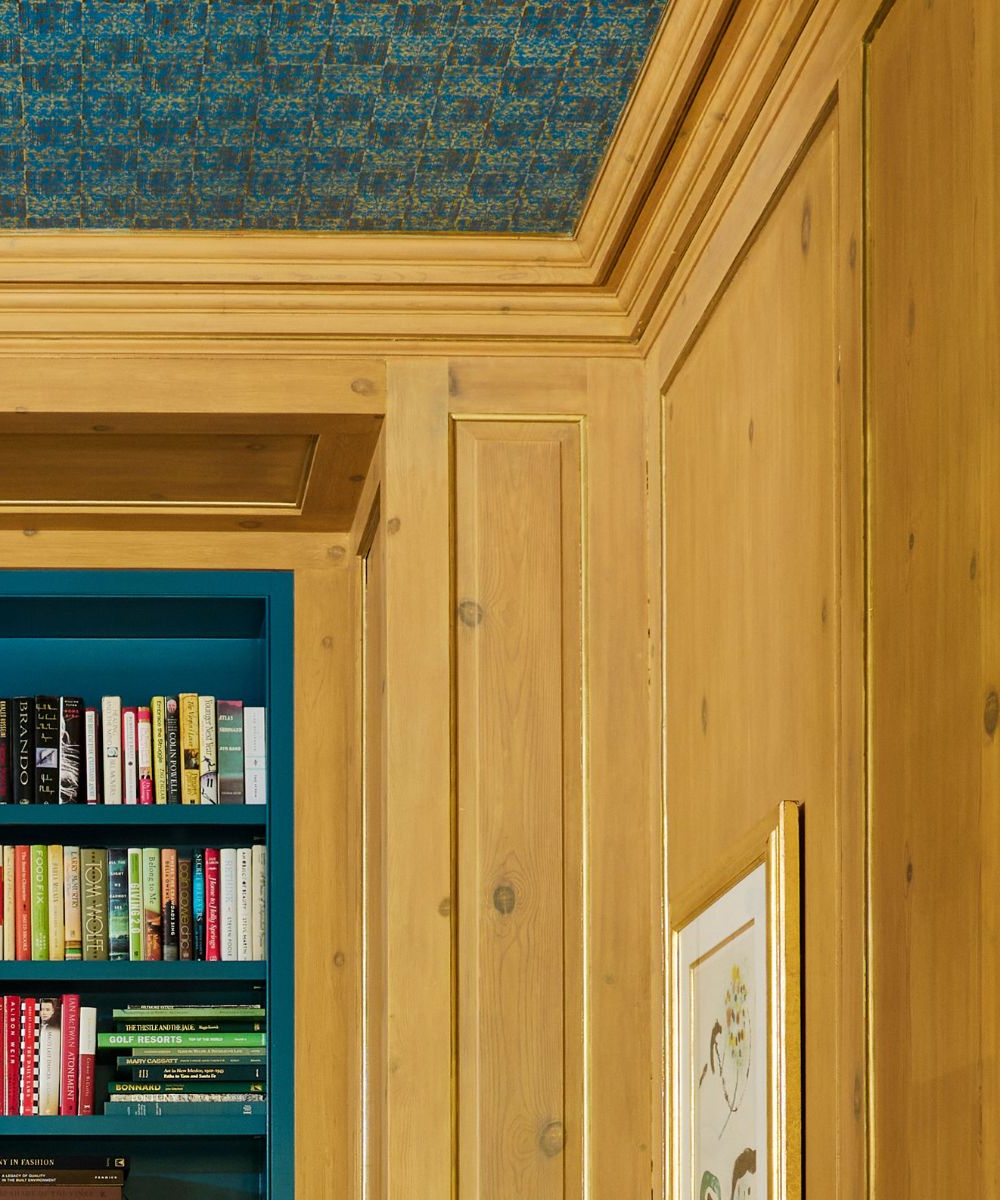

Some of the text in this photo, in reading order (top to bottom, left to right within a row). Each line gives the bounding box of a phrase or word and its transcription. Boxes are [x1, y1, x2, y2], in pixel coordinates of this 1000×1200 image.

[19, 702, 28, 785] BRANDO
[169, 732, 177, 794] COLIN POWELL
[85, 860, 103, 952] TOM WOLFE
[149, 893, 156, 904] Me
